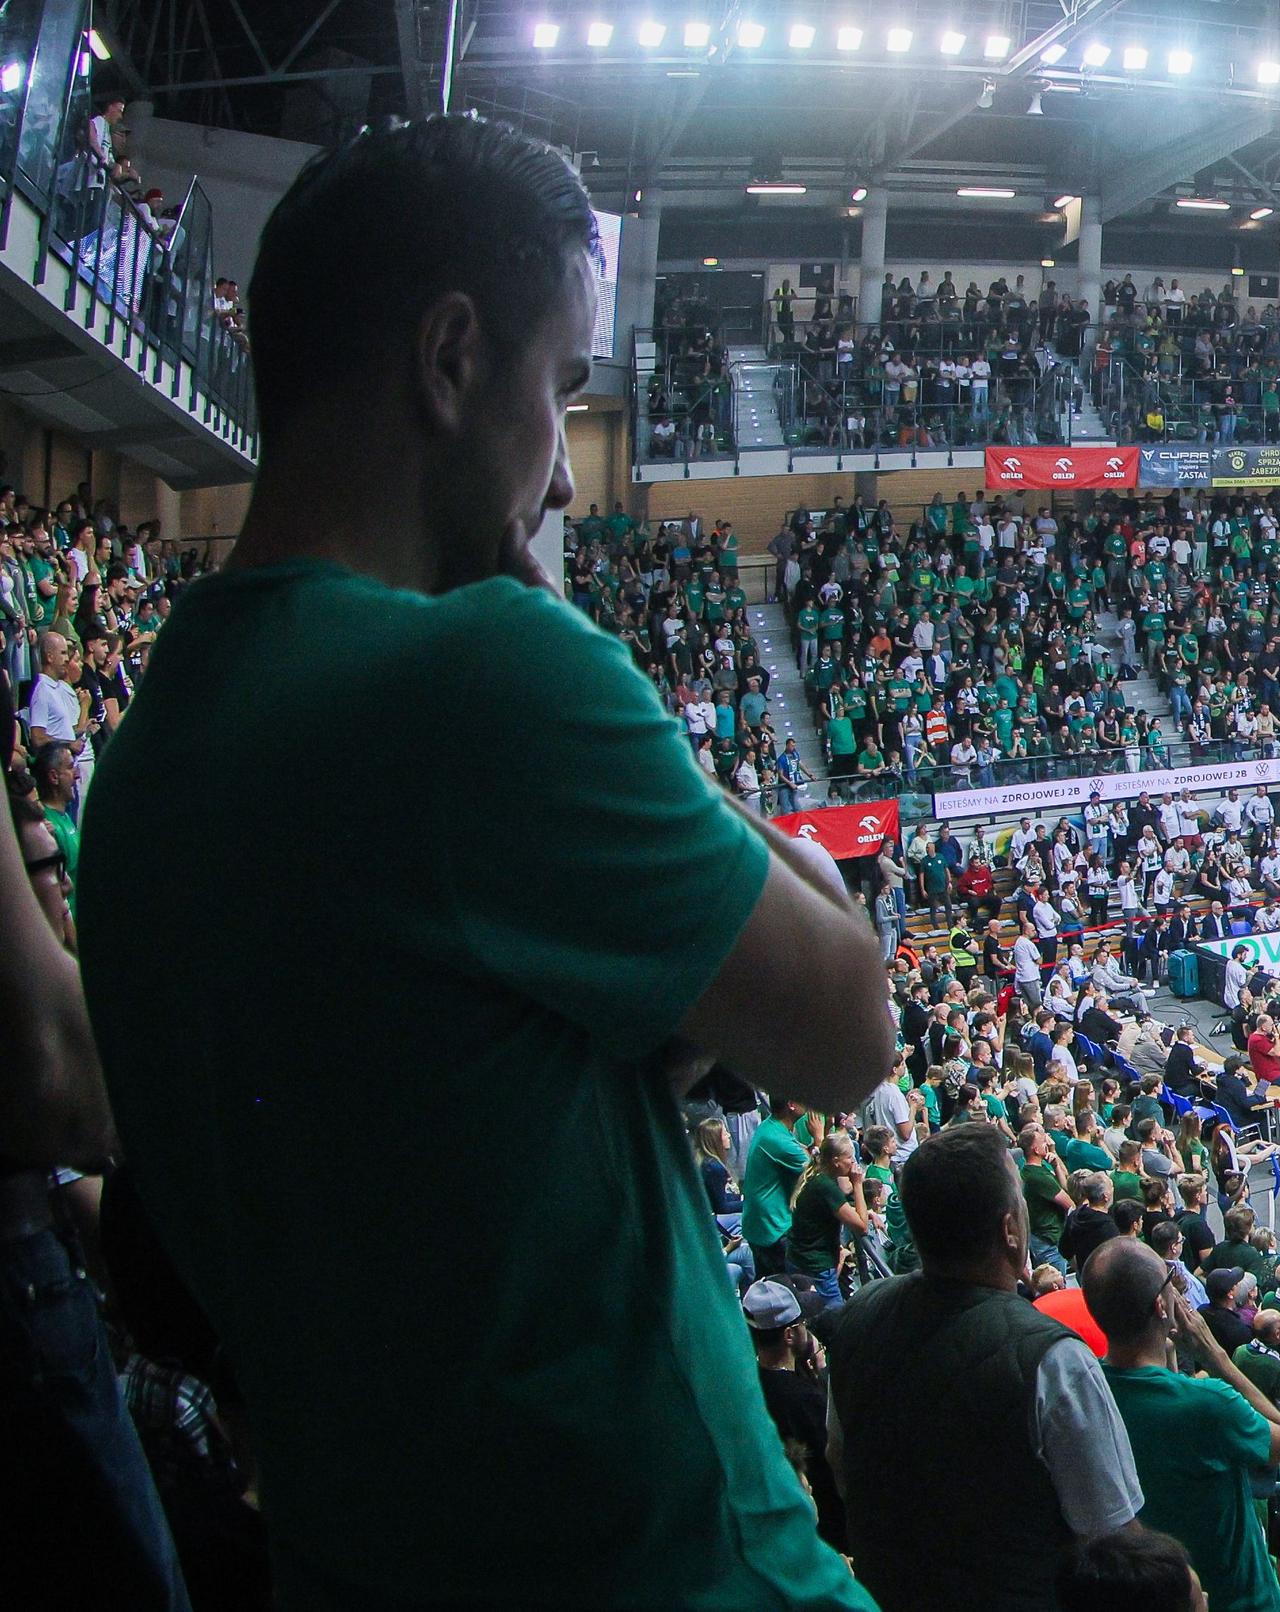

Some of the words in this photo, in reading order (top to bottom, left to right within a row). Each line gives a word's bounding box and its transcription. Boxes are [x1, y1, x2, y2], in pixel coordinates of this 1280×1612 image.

[1001, 472, 1023, 480] ORLEN
[1052, 472, 1075, 480] ORLEN
[1103, 471, 1125, 479] ORLEN
[1179, 471, 1208, 479] ZASTAL
[1114, 778, 1155, 791] JESTEŚMY
[1157, 778, 1171, 786] NA
[1174, 770, 1233, 785] ZDROJOWEJ
[1235, 769, 1248, 778] 2B
[939, 796, 982, 811] JESTEŚMY
[984, 796, 999, 805] NA
[1002, 789, 1065, 804] ZDROJOWEJ
[1067, 787, 1081, 796] 2B
[857, 833, 885, 844] ORLEN
